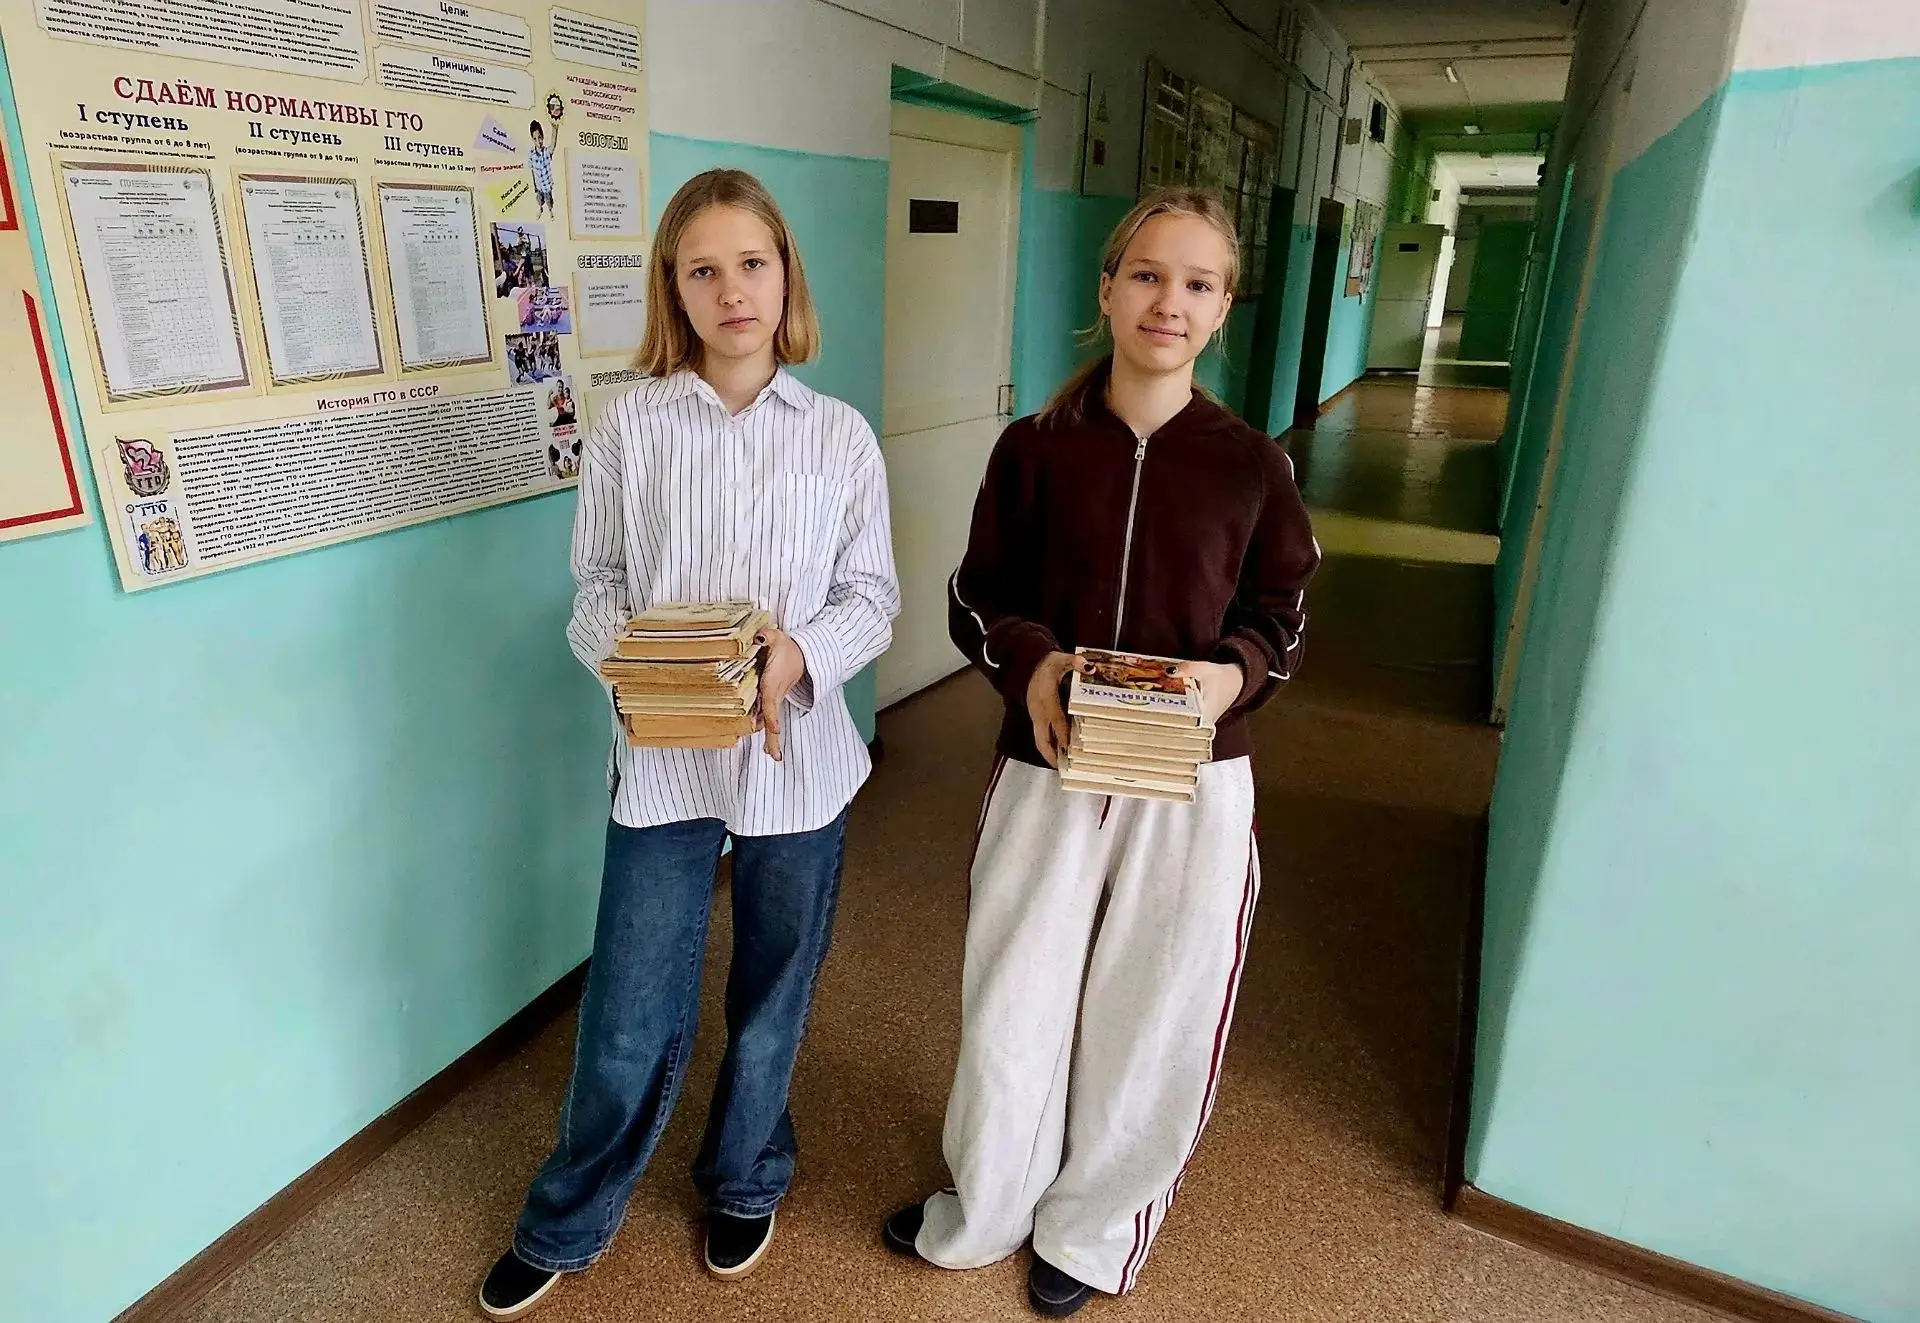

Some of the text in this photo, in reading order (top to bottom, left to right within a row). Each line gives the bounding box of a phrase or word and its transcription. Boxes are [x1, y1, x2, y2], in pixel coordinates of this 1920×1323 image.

[439, 1, 469, 17] Цели:
[46, 16, 86, 27] школьного
[48, 26, 91, 37] количества
[92, 32, 134, 44] спортивных
[432, 56, 486, 75] Принципы:
[114, 77, 423, 132] СДАЁМ НОРМАТИВЫ ГТО
[77, 104, 188, 131] I ступень
[59, 129, 119, 142] (возрастная
[121, 135, 151, 146] группа
[166, 138, 171, 146] 6
[173, 139, 184, 147] до
[193, 141, 211, 150] лет)
[248, 122, 342, 146] II ступень
[493, 127, 507, 138] Сдай
[579, 132, 628, 150] ЗОЛОТЫМ
[235, 146, 282, 157] (возрастная
[283, 149, 308, 159] группа
[344, 156, 359, 164] лет)
[384, 136, 464, 157] III ступень
[374, 158, 411, 168] (возрастная
[578, 255, 642, 268] СЕРЕБРЯНЫМ
[590, 369, 643, 387] БРОНЗОВЫ
[317, 395, 370, 410] История
[373, 390, 396, 404] ГТО
[409, 386, 439, 398] СССР
[173, 434, 214, 444] Всесоюзный
[216, 429, 251, 438] спортивный
[174, 442, 216, 452] Всесоюзным
[217, 438, 242, 446] советом
[242, 432, 278, 443] физической
[176, 448, 224, 460] физкультурной
[137, 475, 161, 489] ГТО
[141, 504, 167, 516] ГТО
[1080, 687, 1187, 706] РОДНИЧОК
